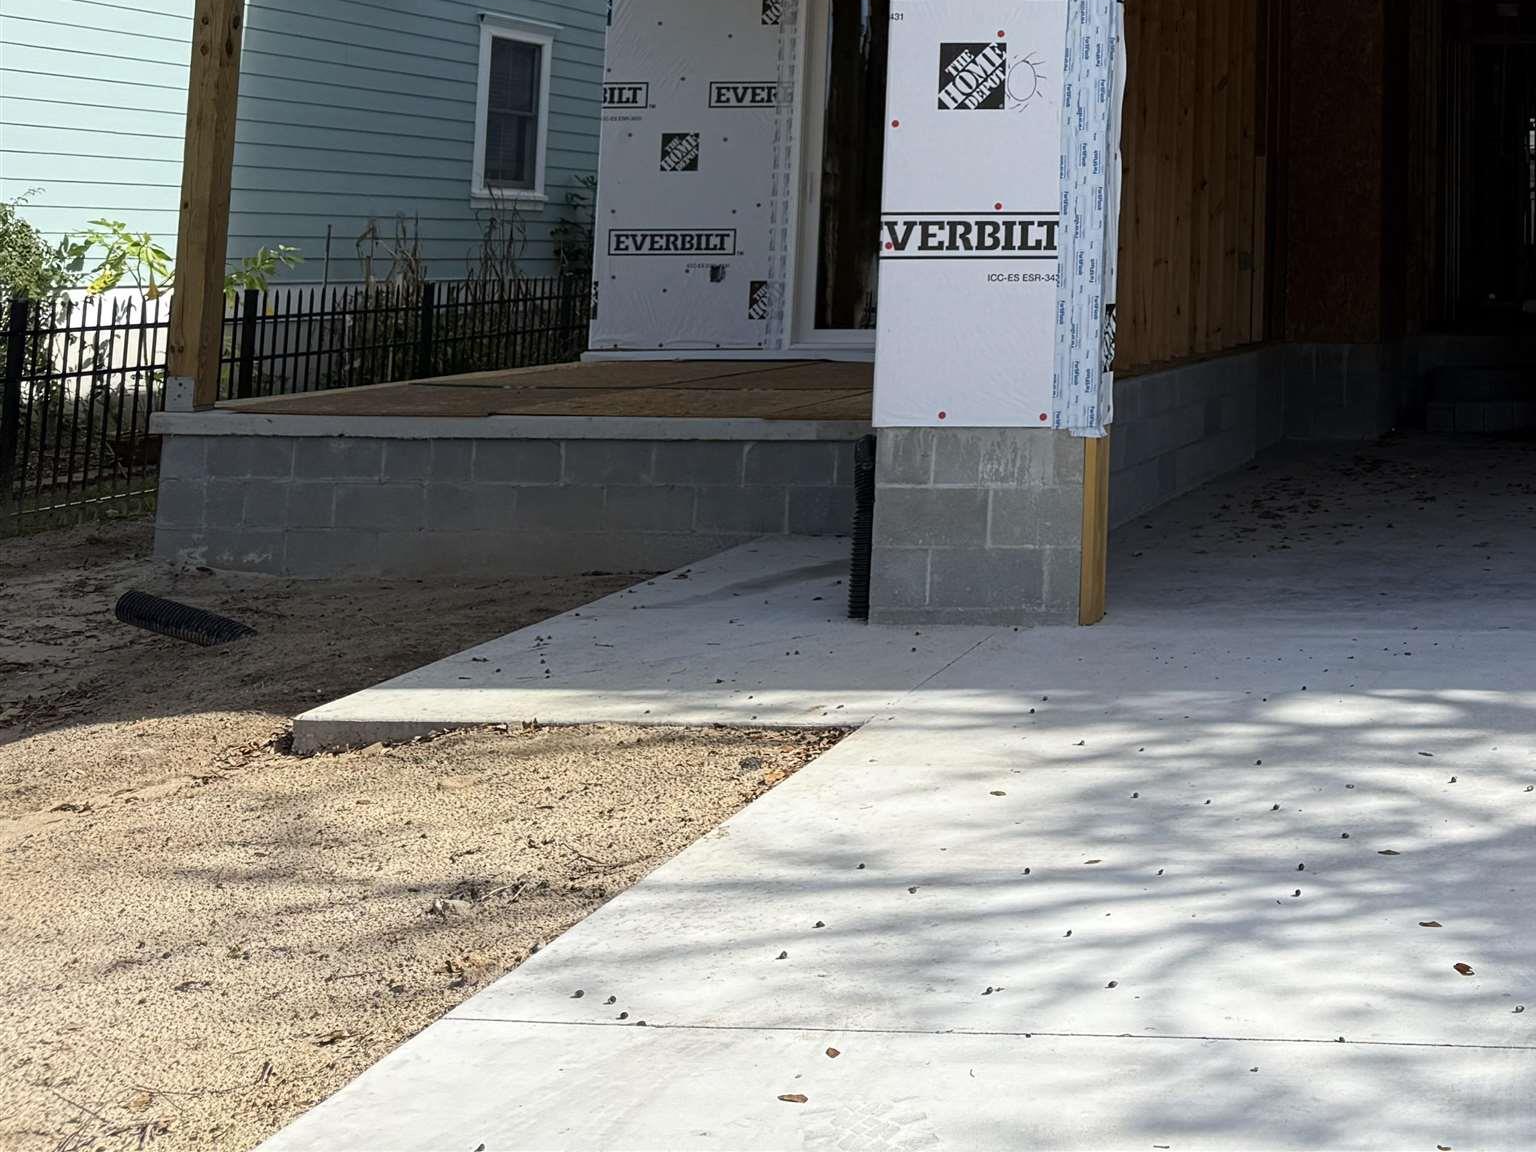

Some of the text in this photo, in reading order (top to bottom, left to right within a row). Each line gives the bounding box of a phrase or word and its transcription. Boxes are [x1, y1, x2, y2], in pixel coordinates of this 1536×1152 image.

[937, 41, 1007, 109] HOME
[945, 48, 975, 78] THE
[964, 66, 1006, 110] DEPOT
[613, 233, 730, 251] EVERBILT
[880, 220, 1059, 251] VERBILT
[987, 273, 1020, 282] ICC-ES
